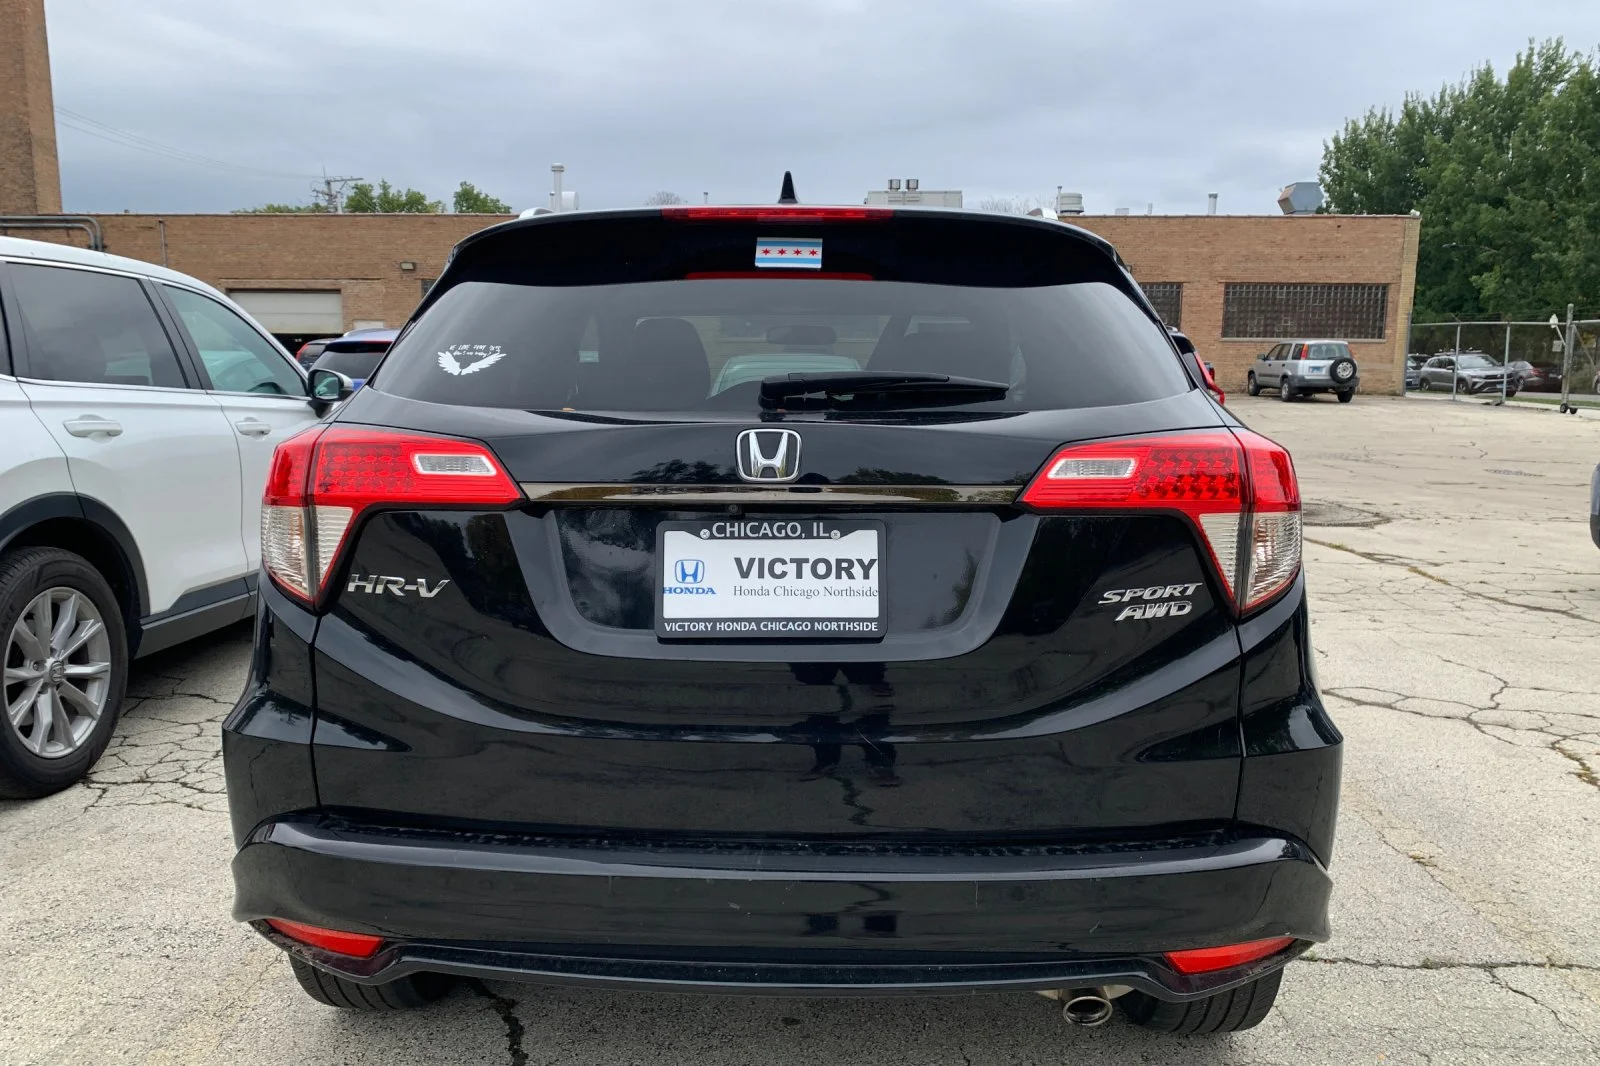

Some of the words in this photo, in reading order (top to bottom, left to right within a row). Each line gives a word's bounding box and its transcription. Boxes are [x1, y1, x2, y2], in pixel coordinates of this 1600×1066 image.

[712, 522, 806, 539] CHICAGO,
[813, 522, 830, 537] IL
[733, 557, 878, 580] VICTORY
[347, 574, 450, 598] HR-V
[663, 586, 717, 595] HONDA
[733, 585, 770, 597] Honda
[773, 585, 820, 600] Chicago
[823, 585, 878, 598] Northside
[1098, 582, 1203, 604] SPORT
[1114, 600, 1192, 621] AWD
[664, 622, 713, 632] VICTORY
[716, 621, 757, 632] HONDA
[760, 621, 811, 632] CHICAGO
[814, 621, 878, 632] NORTHSIDE
